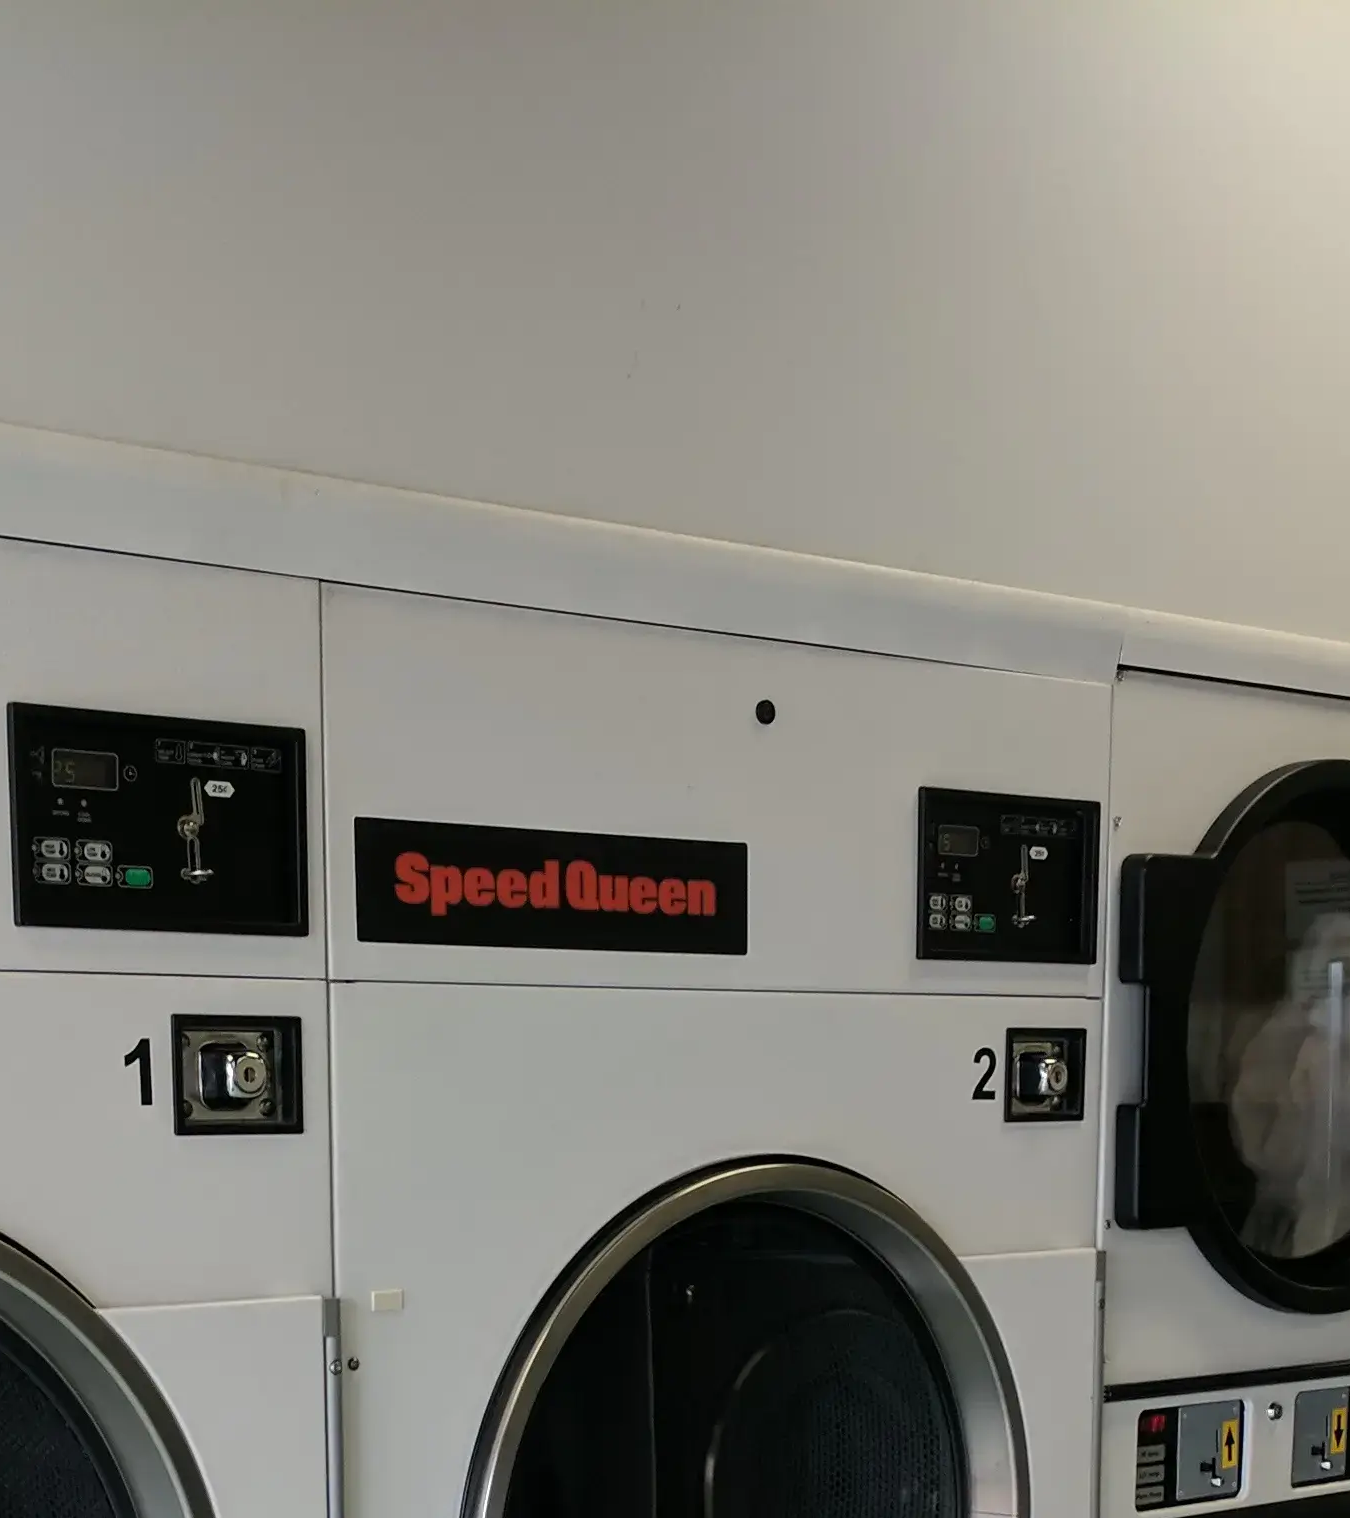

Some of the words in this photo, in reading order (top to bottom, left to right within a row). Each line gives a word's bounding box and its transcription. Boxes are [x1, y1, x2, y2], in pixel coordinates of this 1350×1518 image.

[394, 850, 560, 917] Speed
[565, 859, 717, 917] Queen
[124, 1037, 153, 1106] 1
[972, 1047, 997, 1100] 2
